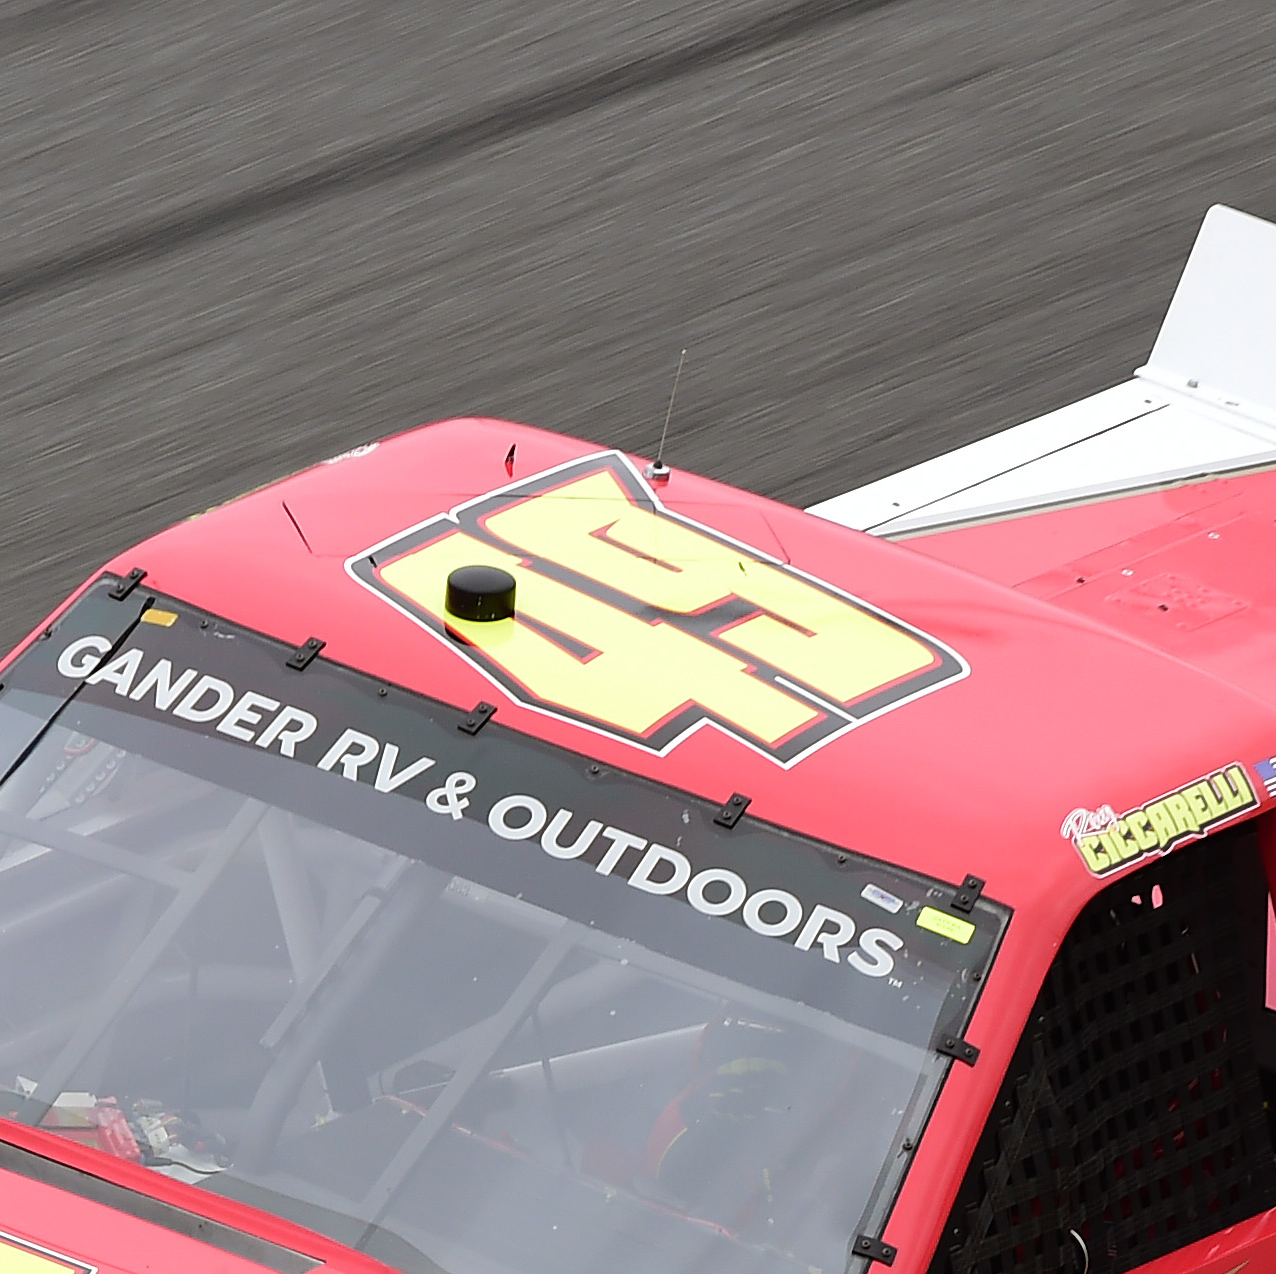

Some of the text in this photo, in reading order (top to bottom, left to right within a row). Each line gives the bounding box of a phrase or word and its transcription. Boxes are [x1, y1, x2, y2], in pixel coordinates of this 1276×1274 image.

[362, 460, 954, 757] 49
[57, 635, 319, 758] GANDER
[318, 727, 435, 795] RV
[426, 771, 477, 820] &
[487, 793, 905, 978] OUTDOORS
[1080, 767, 1253, 872] CICCARELLI
